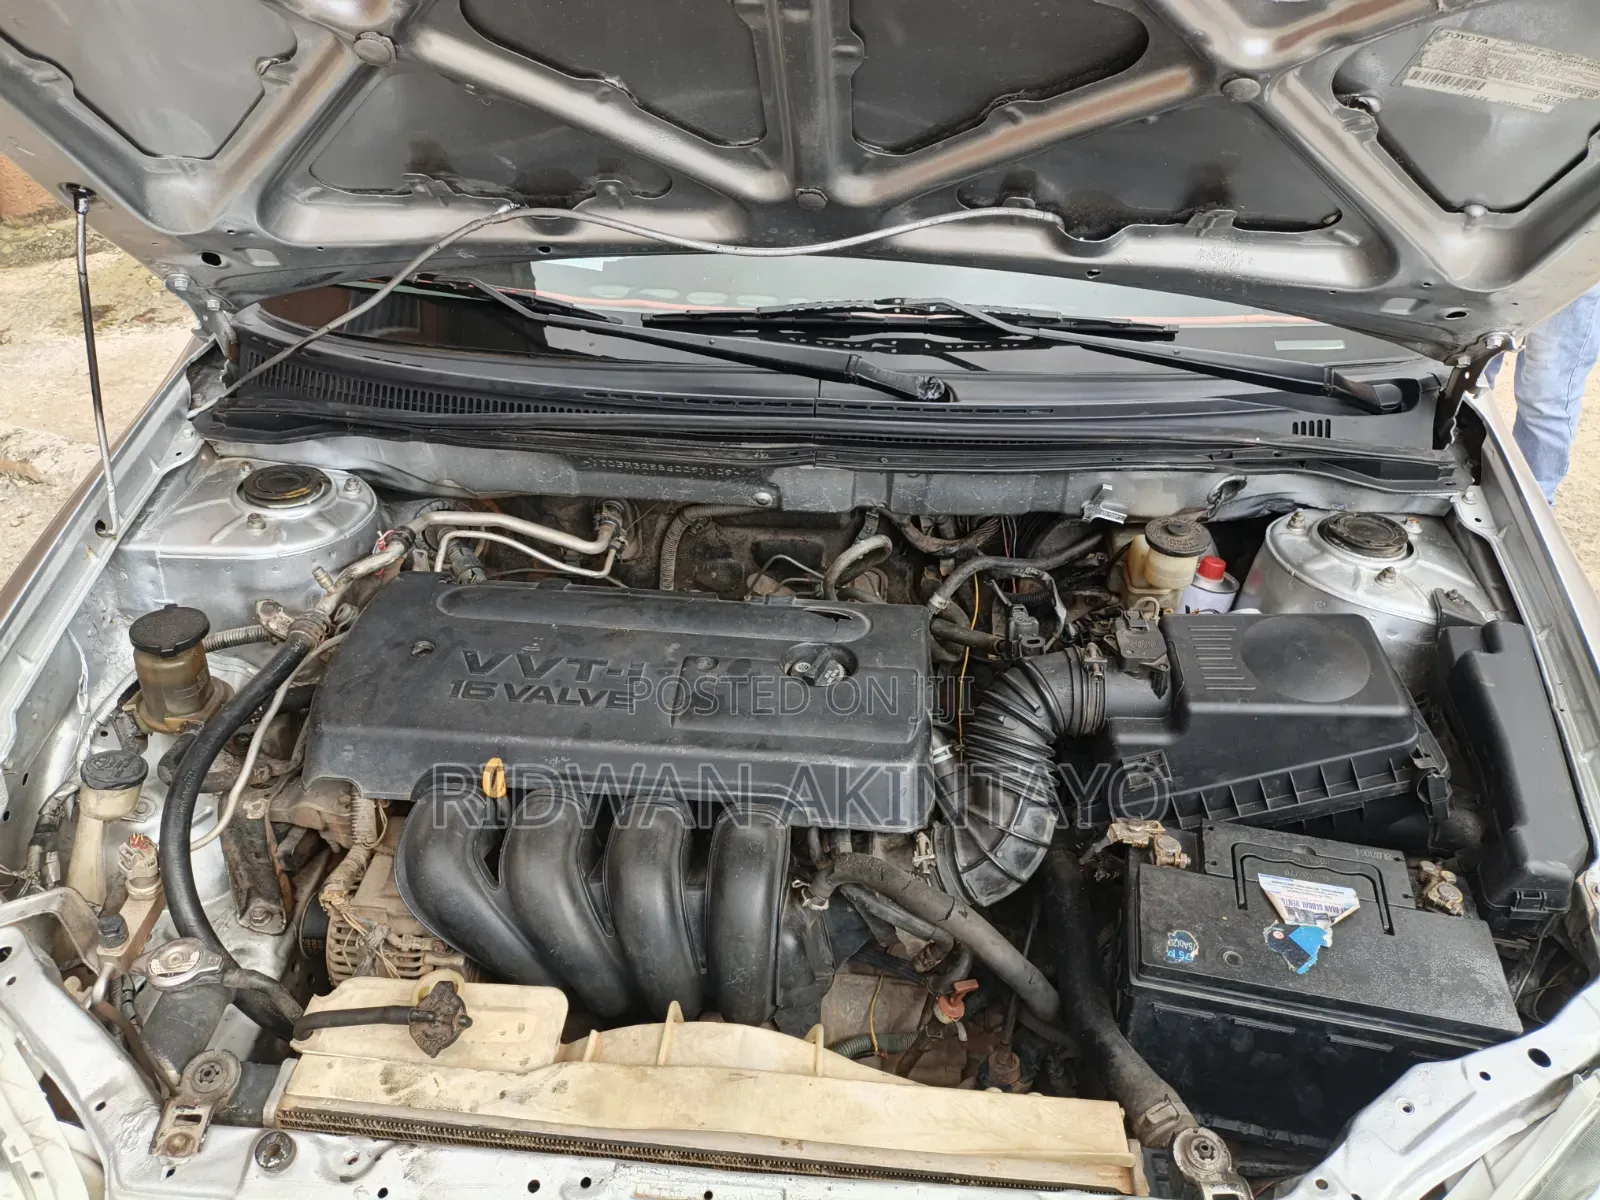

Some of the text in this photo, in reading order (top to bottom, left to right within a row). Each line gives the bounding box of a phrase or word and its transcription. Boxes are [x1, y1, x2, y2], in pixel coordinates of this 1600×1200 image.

[1444, 31, 1489, 45] TOYOTA
[462, 650, 645, 683] VVT-i
[449, 679, 635, 709] 16 VALVE
